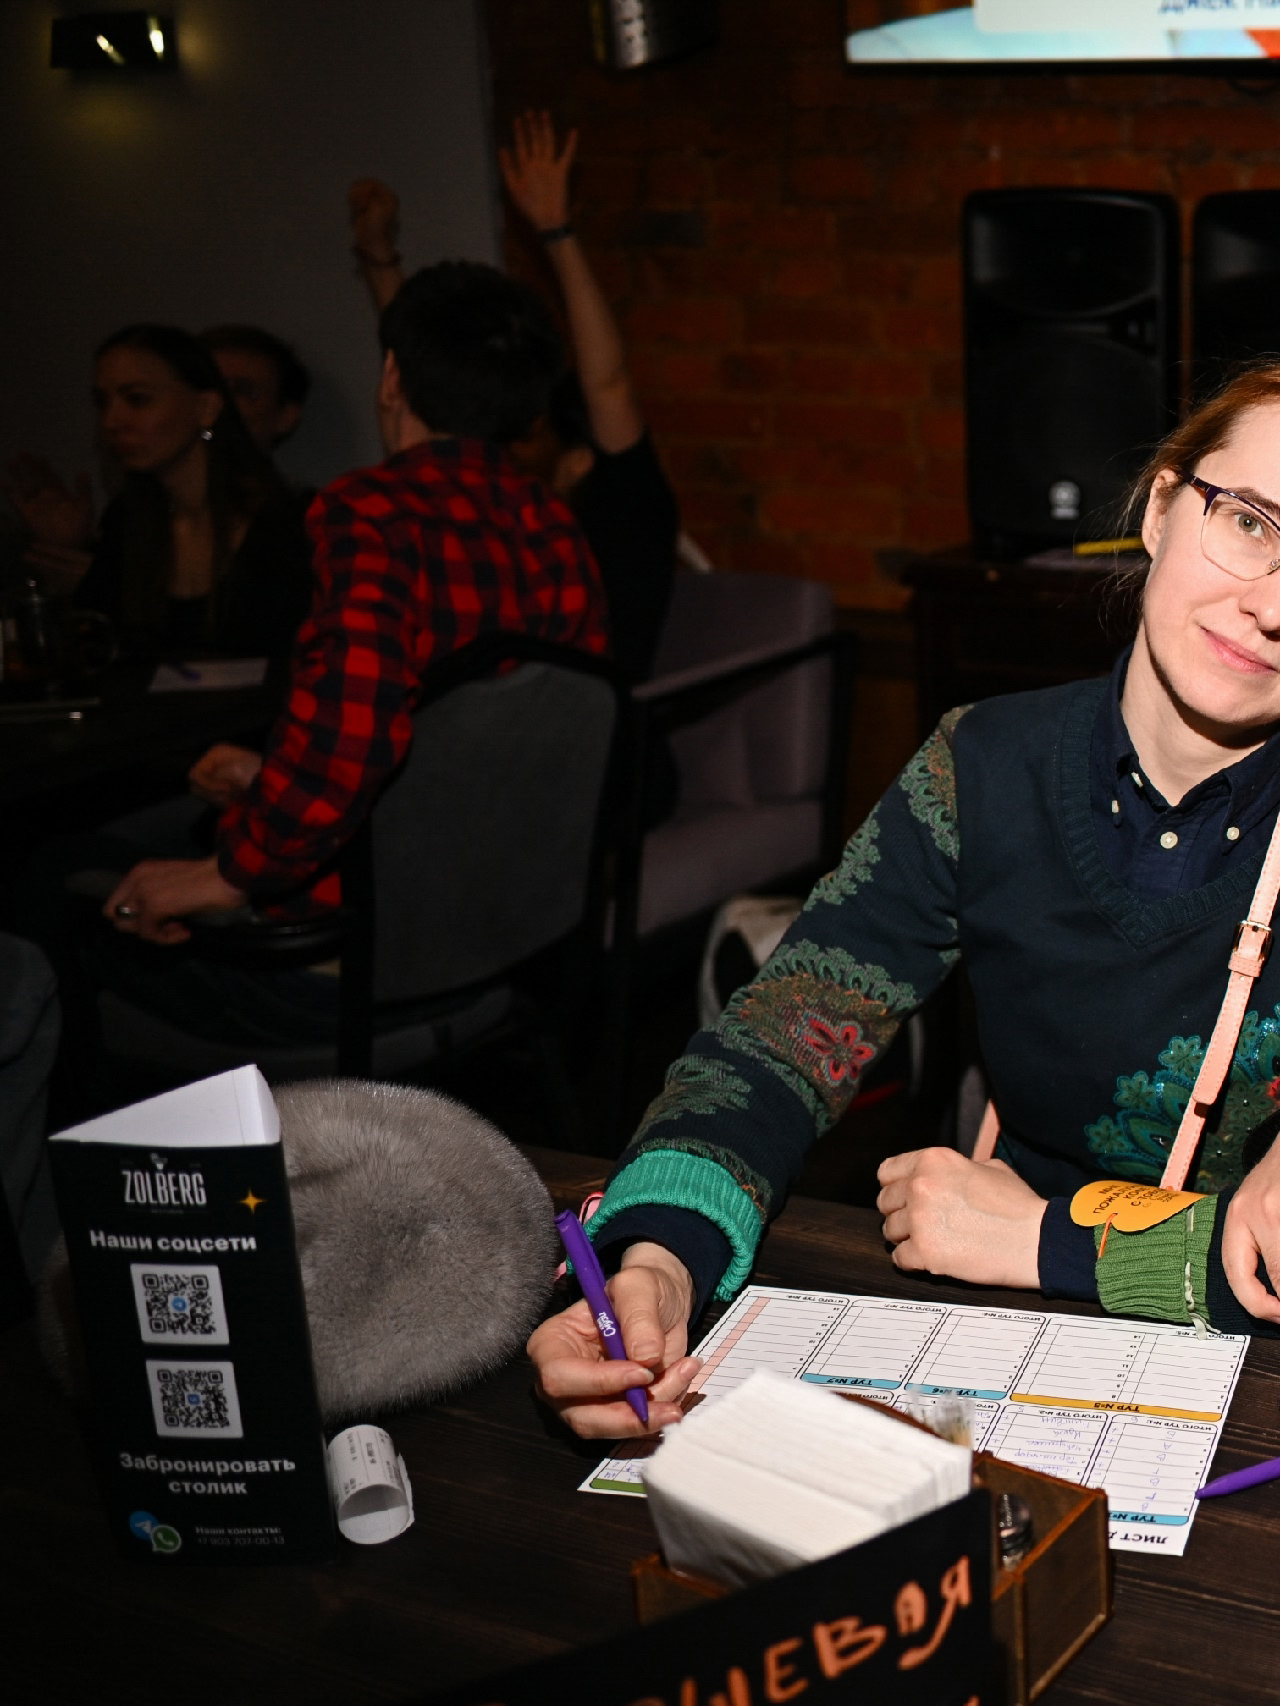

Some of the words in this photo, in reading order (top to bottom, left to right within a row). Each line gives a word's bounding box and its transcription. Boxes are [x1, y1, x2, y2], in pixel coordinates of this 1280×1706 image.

[120, 1168, 208, 1206] ZOLBERG
[88, 1228, 153, 1250] Наши
[157, 1234, 258, 1254] соцсети
[850, 1378, 873, 1386] ТУР
[1182, 1423, 1212, 1431] ИТОГО
[118, 1452, 297, 1476] Забронировать
[167, 1481, 249, 1496] столик
[1131, 1515, 1157, 1523] ТУР
[1120, 1532, 1168, 1544] ЛИСТ
